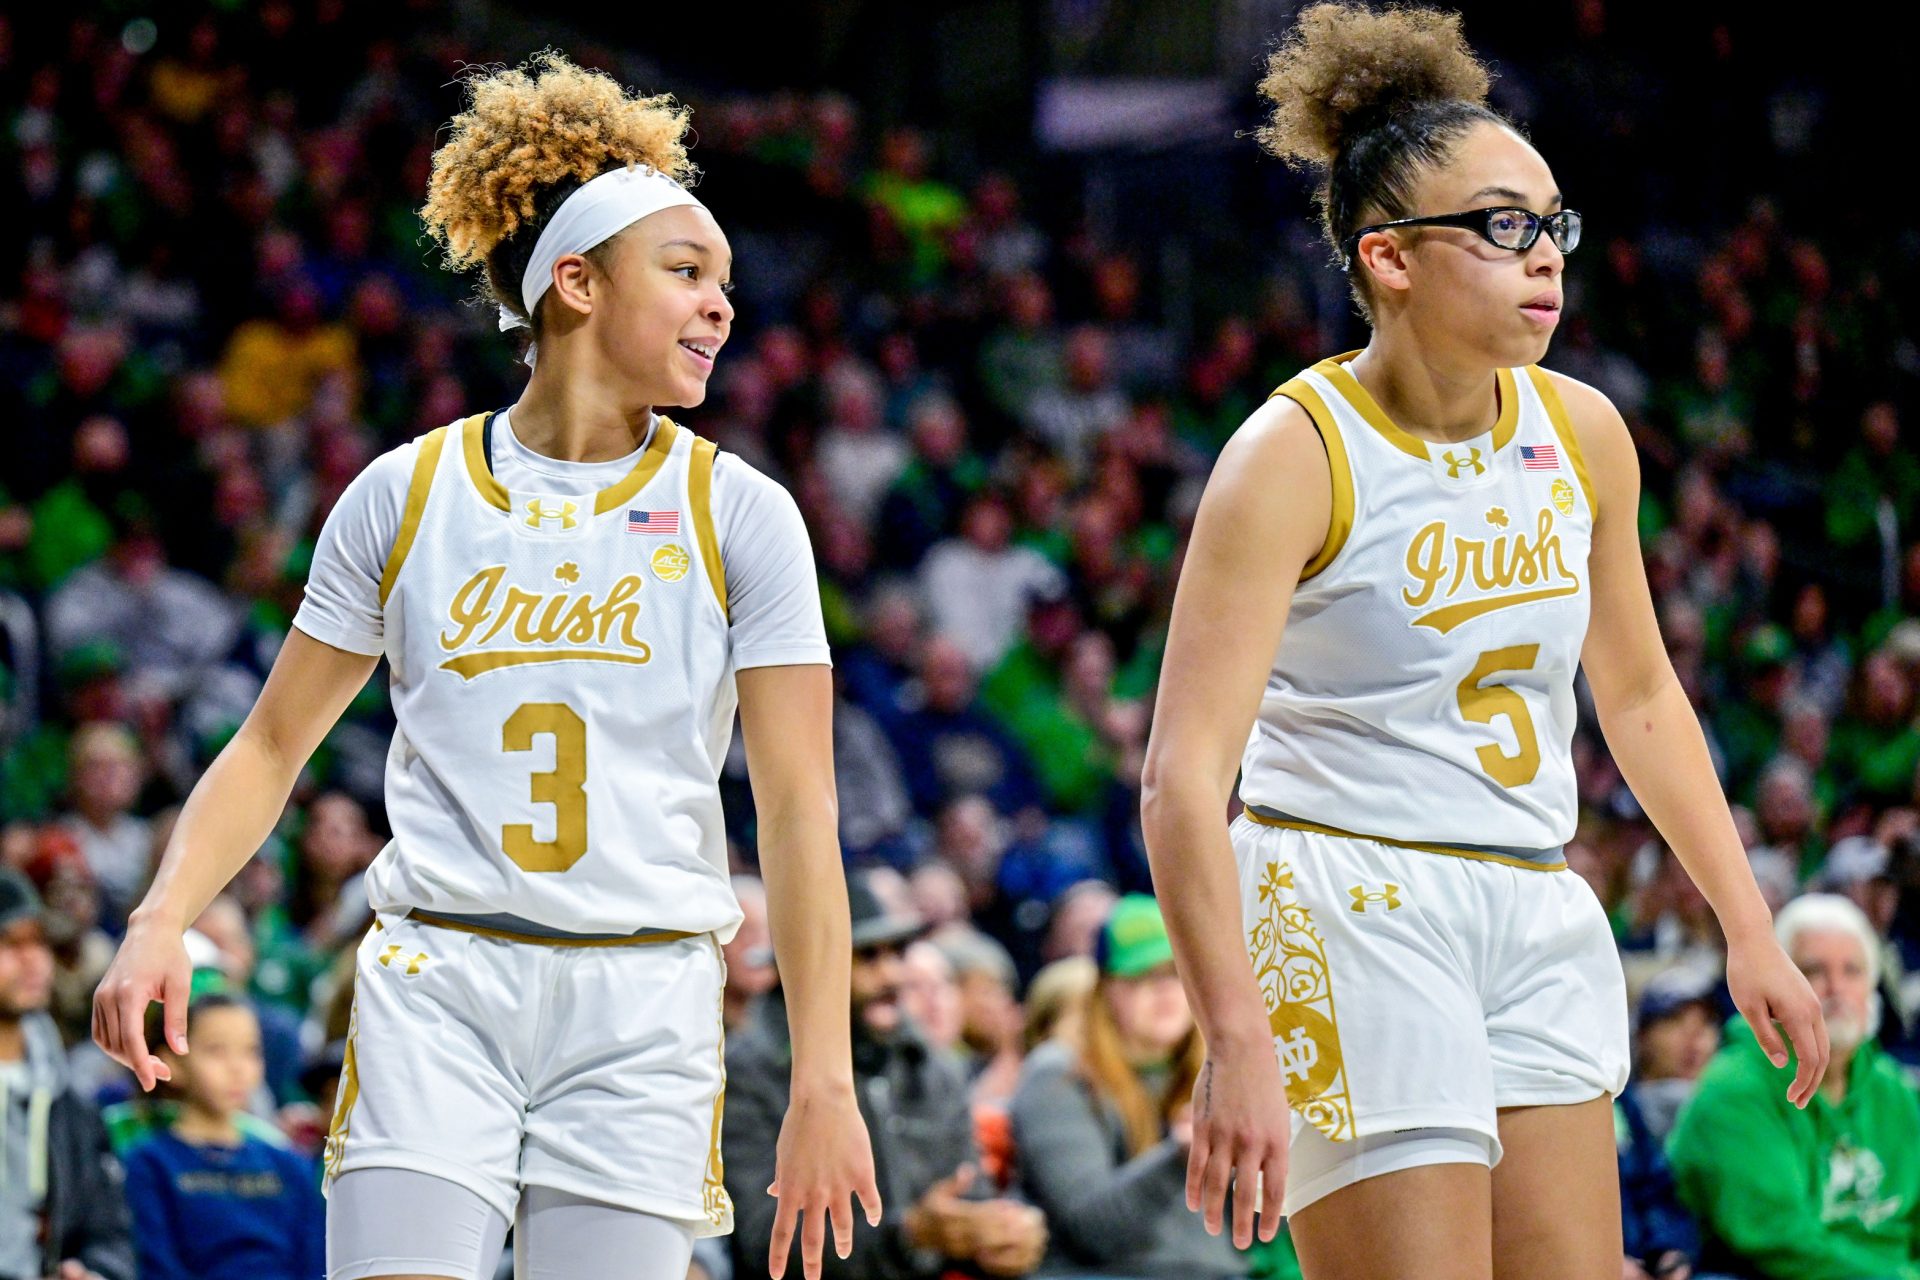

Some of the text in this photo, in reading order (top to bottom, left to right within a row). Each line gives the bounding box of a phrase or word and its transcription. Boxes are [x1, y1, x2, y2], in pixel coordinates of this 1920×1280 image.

[1555, 489, 1574, 499] ACC
[655, 555, 689, 566] ACC
[1402, 508, 1580, 608] Irish
[440, 563, 651, 652] Irish
[1456, 643, 1541, 789] 5
[502, 703, 588, 873] 3
